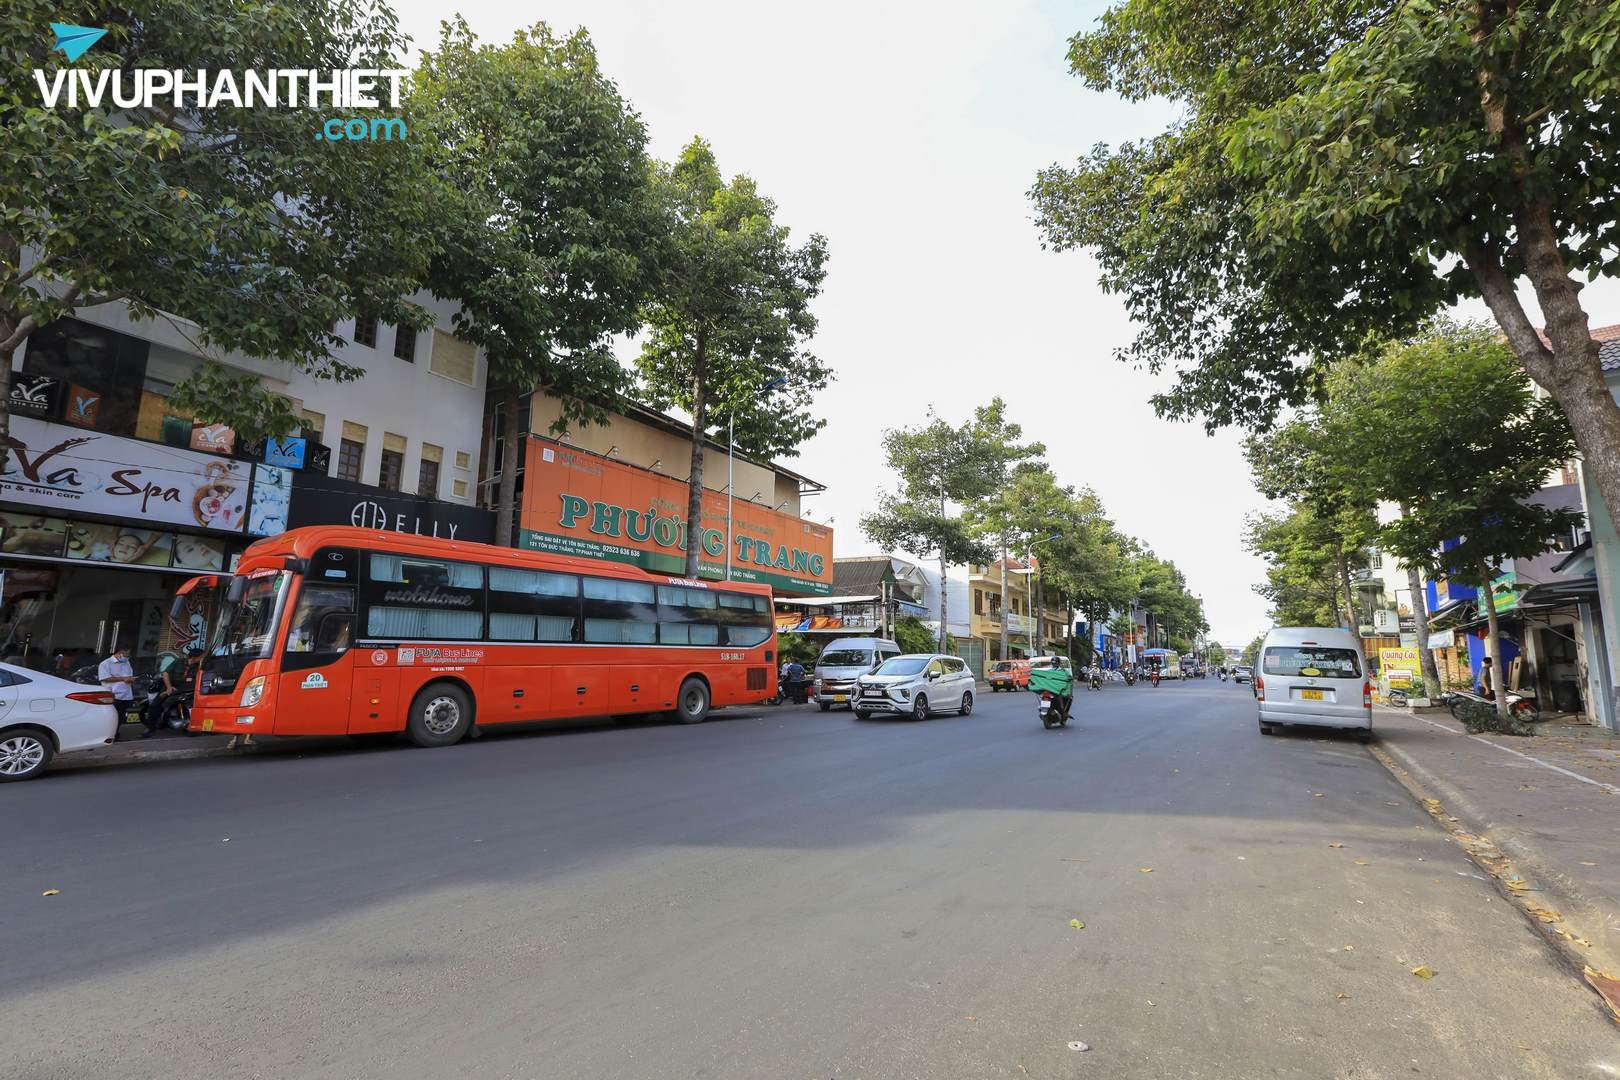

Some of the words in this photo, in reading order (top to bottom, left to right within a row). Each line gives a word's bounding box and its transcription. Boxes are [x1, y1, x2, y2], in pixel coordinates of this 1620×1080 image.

[29, 488, 54, 496] skin
[56, 492, 81, 500] care
[106, 470, 182, 513] Spa
[395, 513, 458, 540] ELLY
[735, 534, 824, 577] TRANG
[415, 647, 441, 658] FUTA
[442, 648, 461, 658] Bus
[461, 648, 484, 658] Lines
[310, 674, 321, 682] 20
